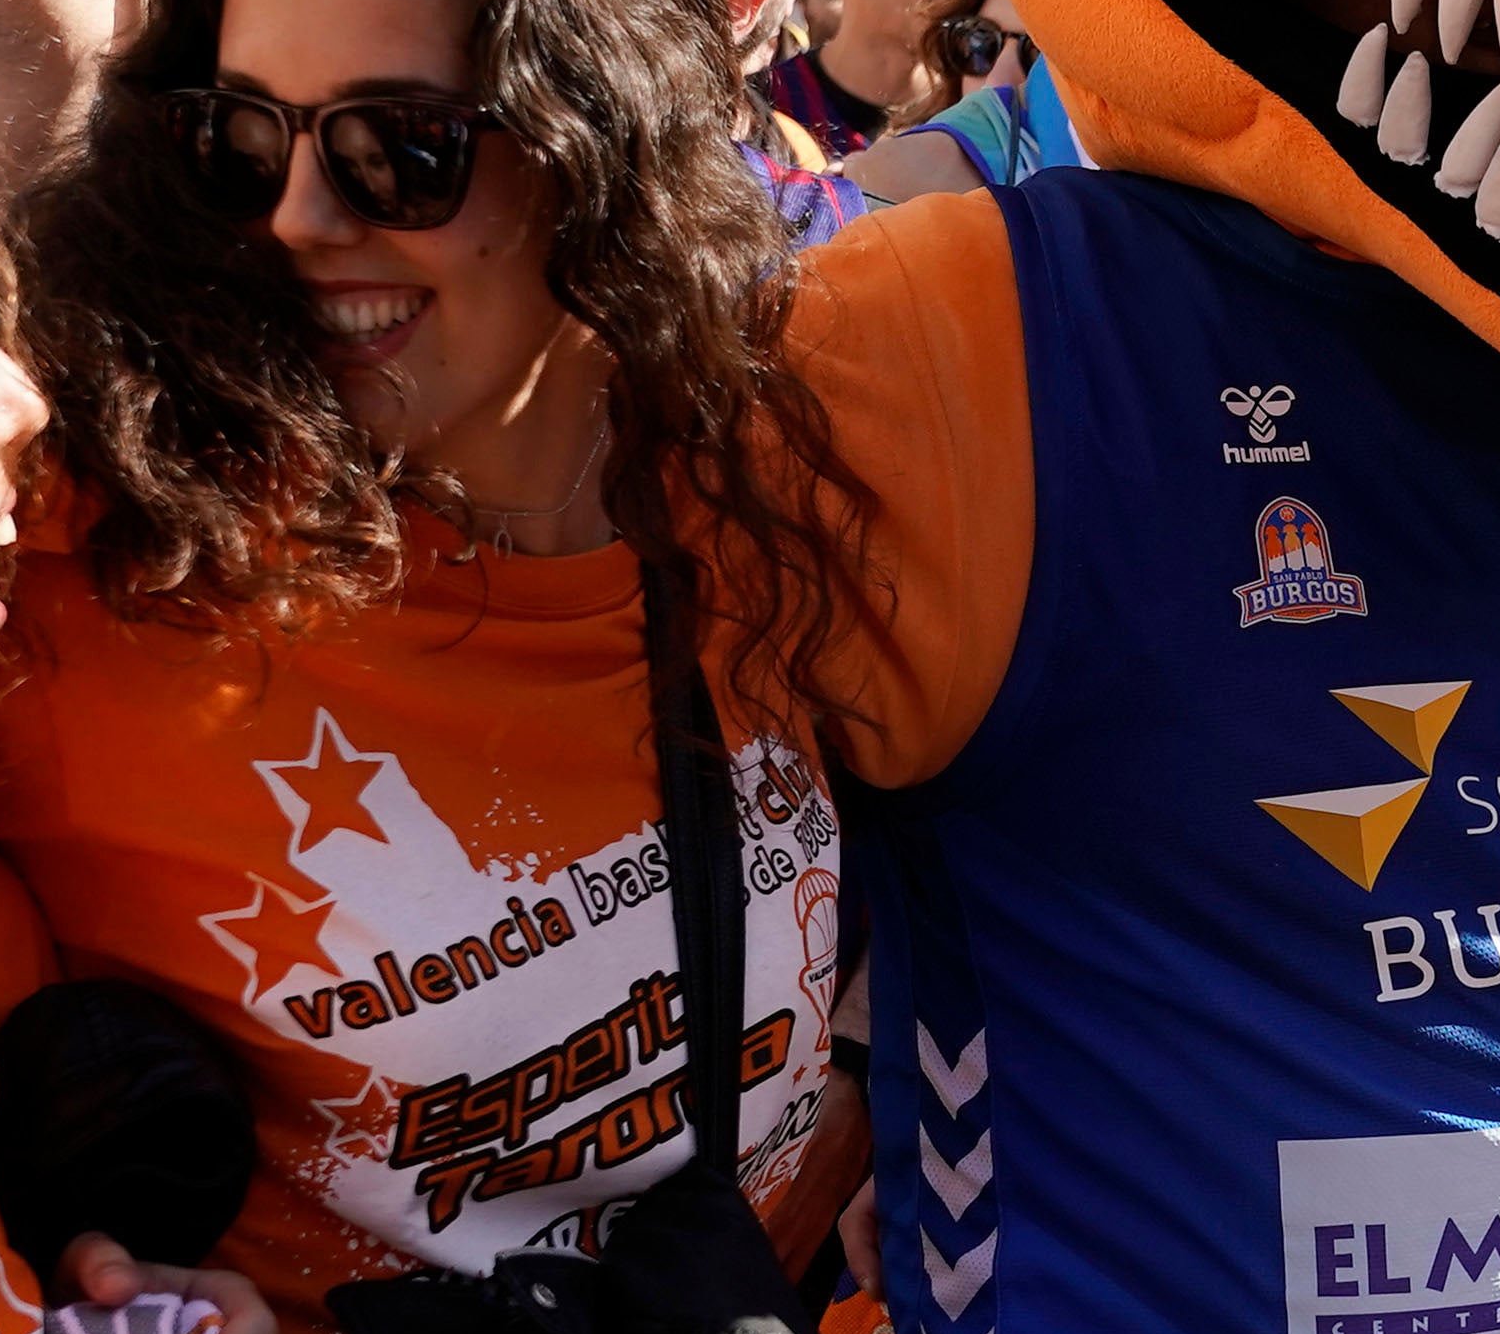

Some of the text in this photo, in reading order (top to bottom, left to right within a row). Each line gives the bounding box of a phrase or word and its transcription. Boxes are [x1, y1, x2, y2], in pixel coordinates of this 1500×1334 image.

[1222, 440, 1312, 465] hummel
[1251, 580, 1357, 614] BURGOS
[1272, 571, 1324, 584] SAN PABLO
[749, 800, 838, 897] de 1986
[283, 896, 577, 1039] valencia
[389, 969, 688, 1168] Esperit
[415, 1008, 797, 1234] Tarona
[1313, 1223, 1411, 1298] EL
